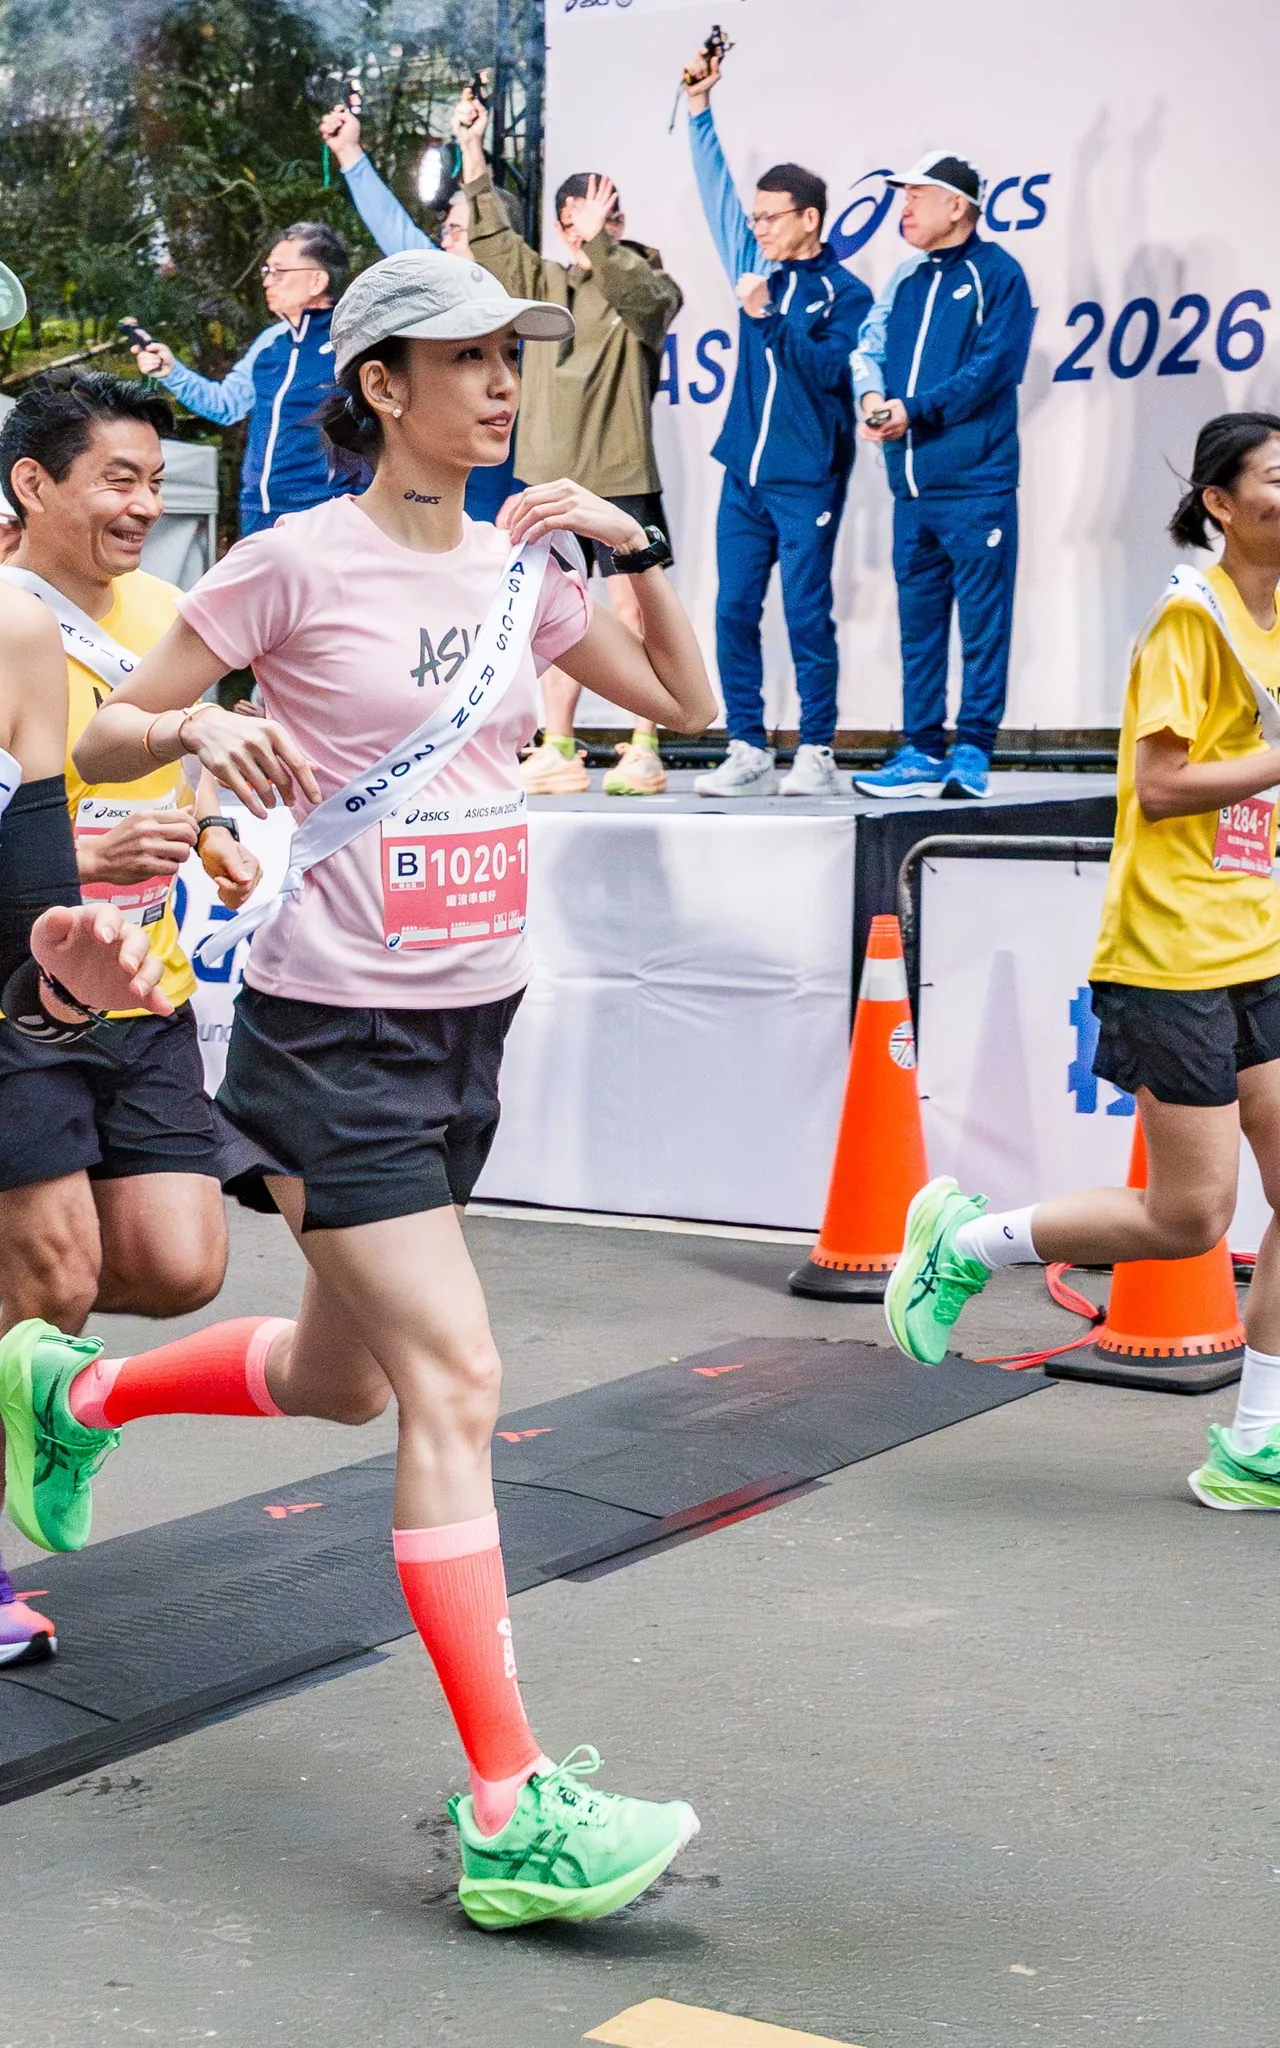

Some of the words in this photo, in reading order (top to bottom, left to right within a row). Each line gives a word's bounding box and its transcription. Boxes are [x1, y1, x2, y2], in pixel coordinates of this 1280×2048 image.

[1053, 289, 1271, 382] 2026
[496, 561, 525, 651] ASICS
[60, 622, 134, 673] ASIC
[451, 664, 495, 729] RUN
[345, 743, 435, 813] 2026
[465, 807, 489, 819] ASICS
[490, 805, 503, 816] RUN
[504, 802, 519, 814] 2026
[398, 852, 419, 877] B
[430, 838, 526, 887] 1020-1
